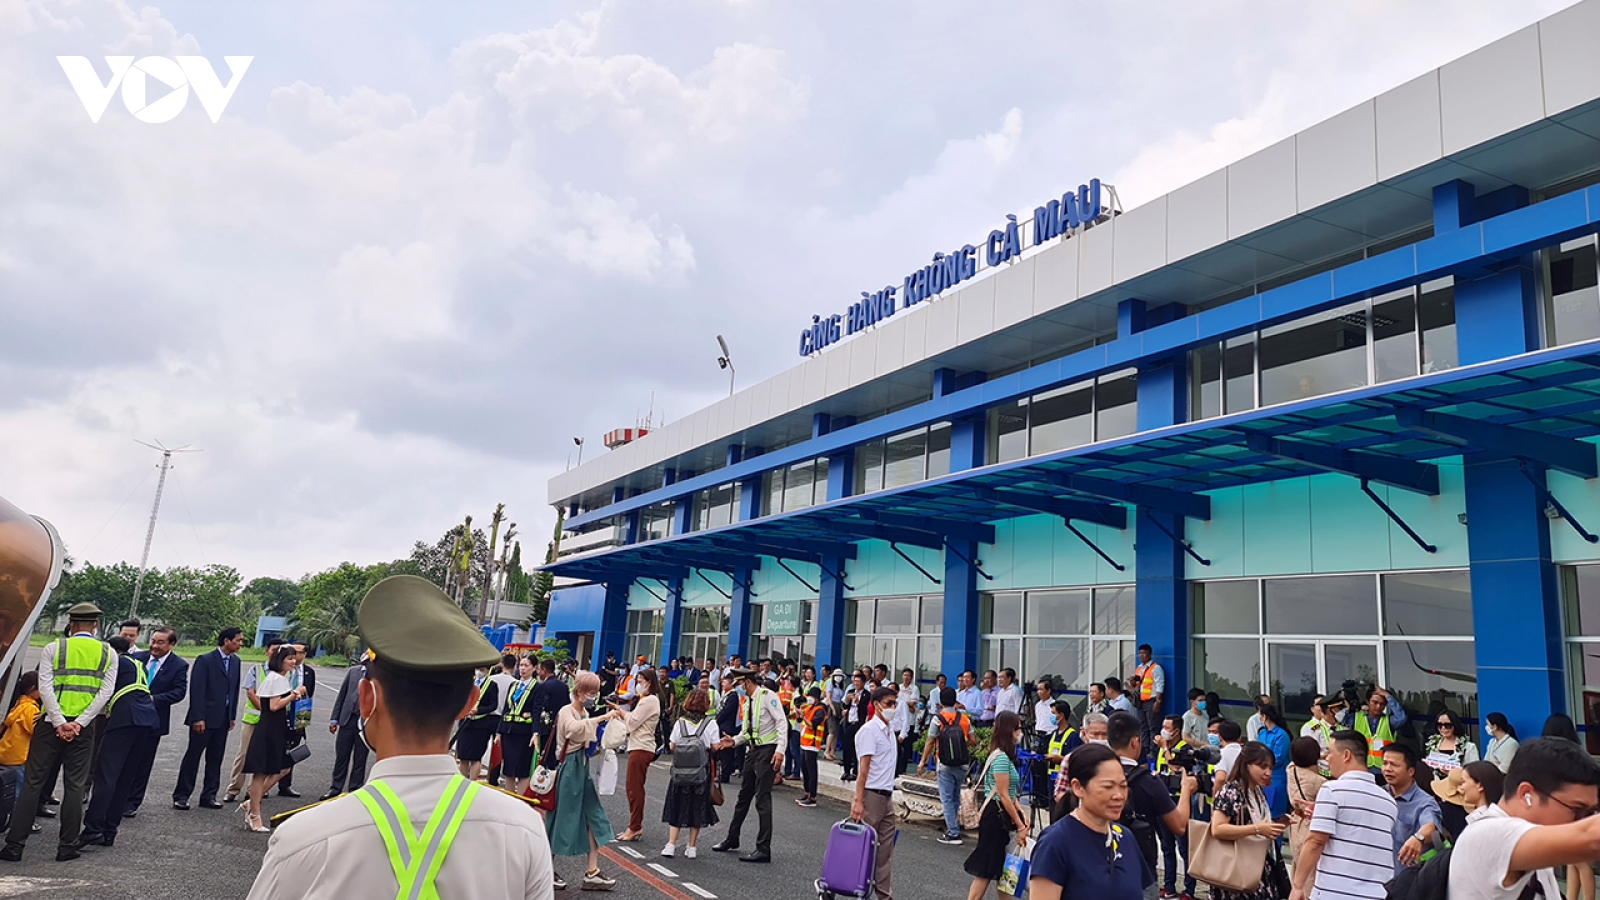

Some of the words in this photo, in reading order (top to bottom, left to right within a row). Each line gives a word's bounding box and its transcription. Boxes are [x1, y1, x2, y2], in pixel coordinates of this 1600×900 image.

[799, 314, 841, 356] CẢNG
[846, 285, 896, 335] HÀNG
[903, 244, 976, 308] KHÔNG
[986, 214, 1021, 267] CÀ
[1034, 178, 1101, 246] MAU
[774, 604, 784, 615] GA
[767, 619, 796, 631] Departure
